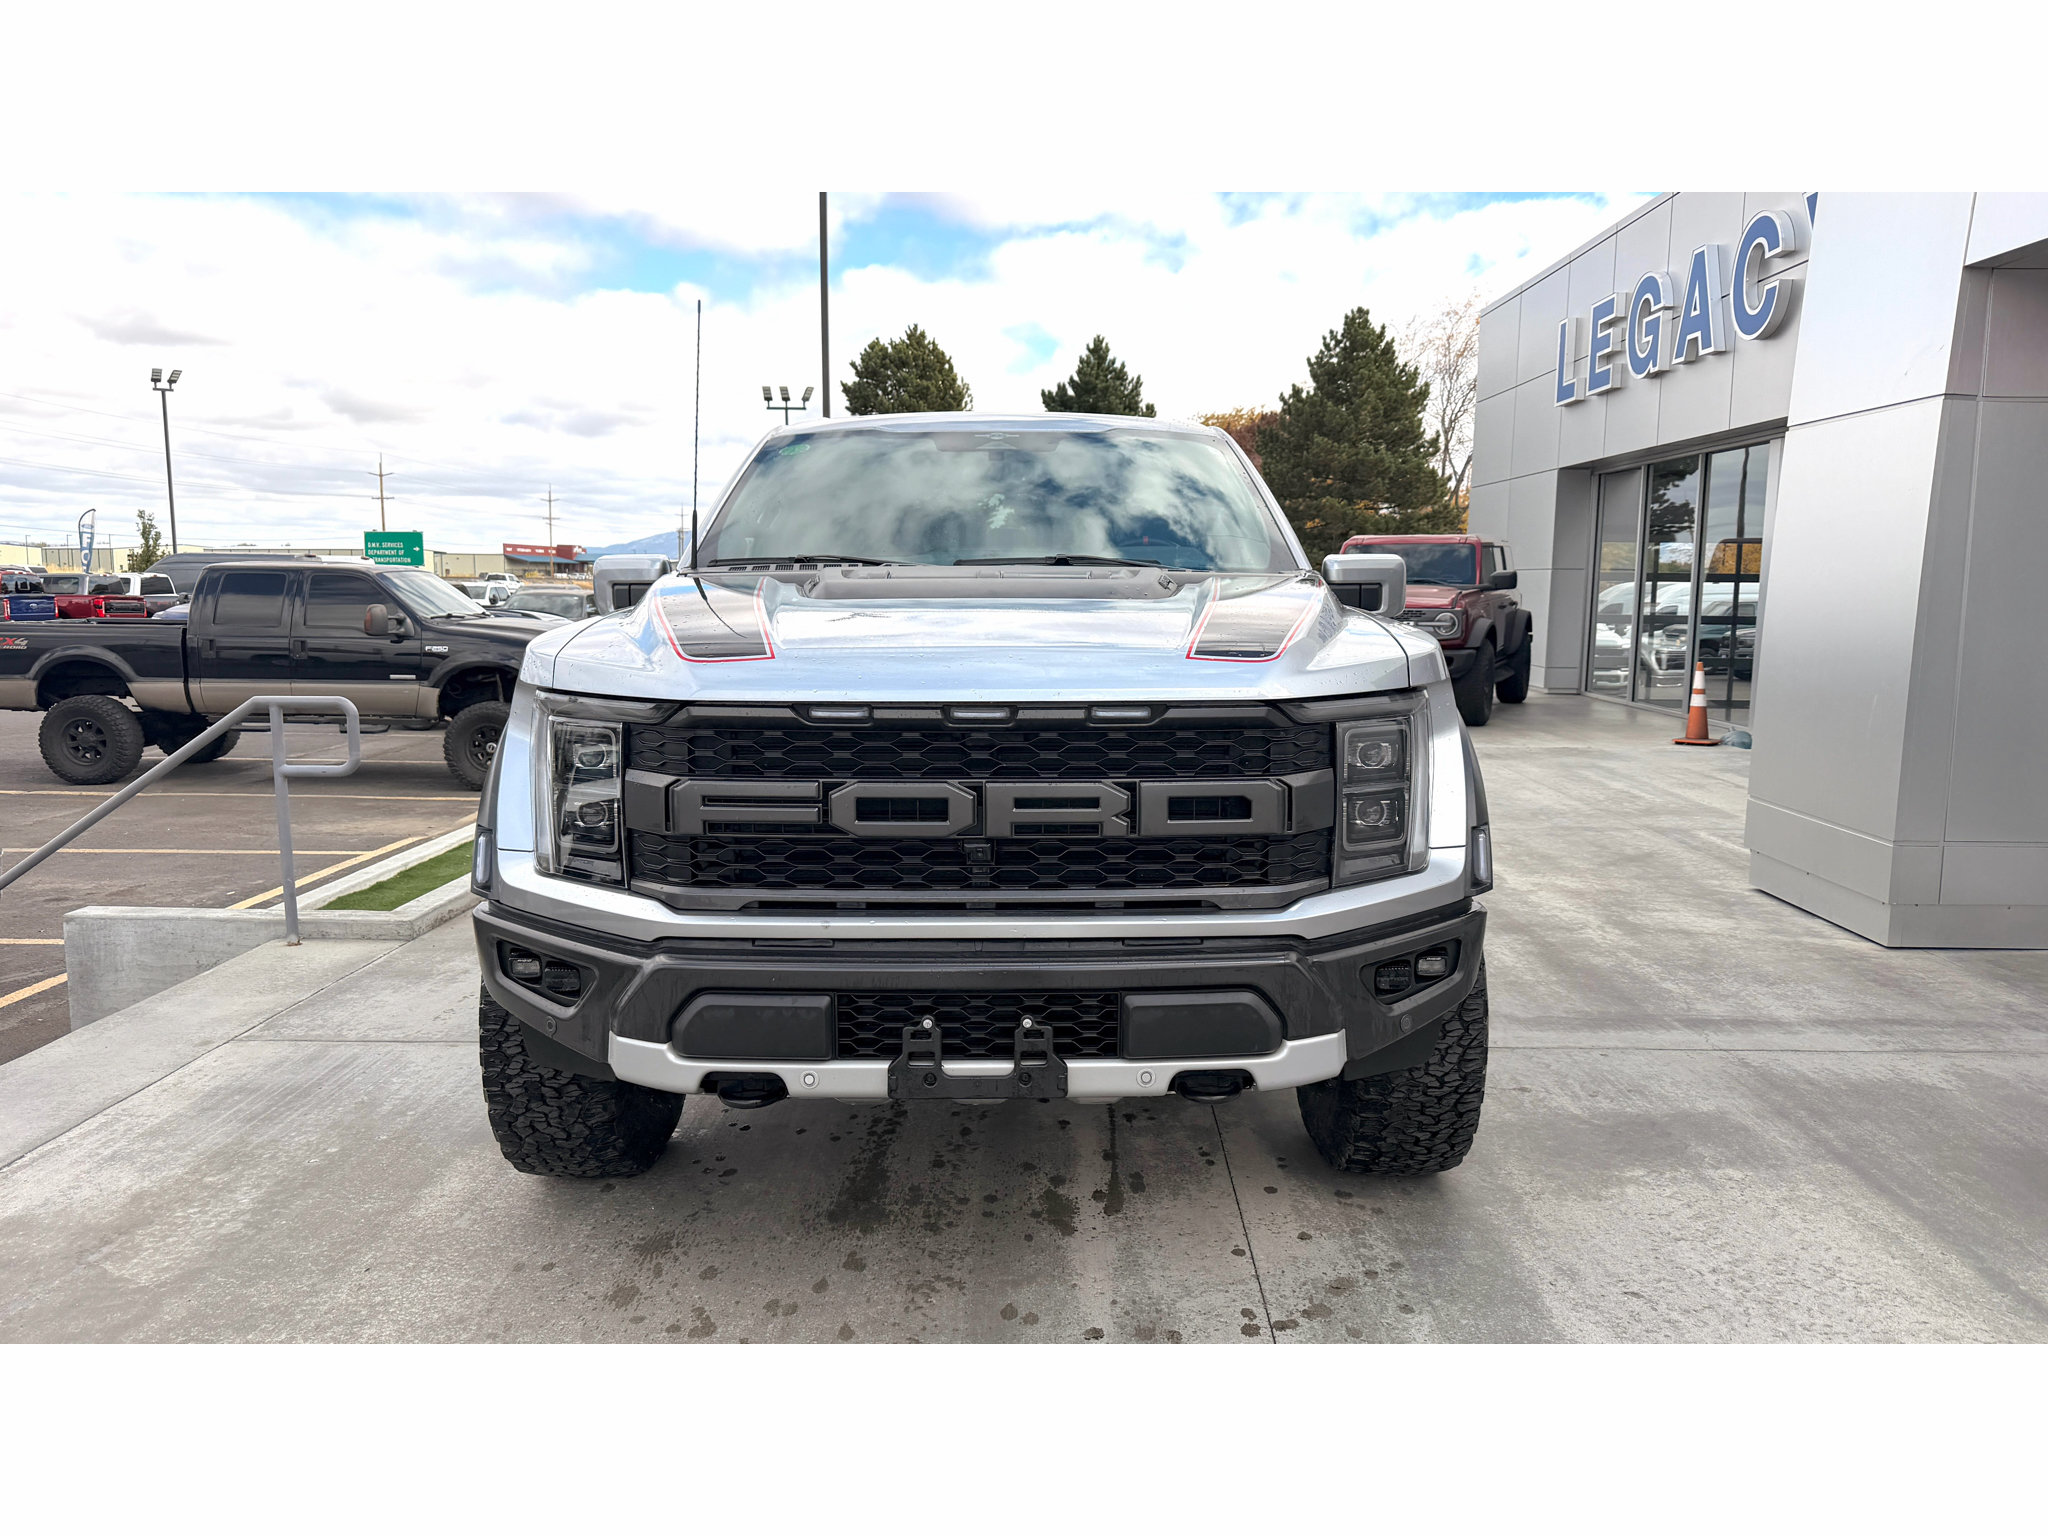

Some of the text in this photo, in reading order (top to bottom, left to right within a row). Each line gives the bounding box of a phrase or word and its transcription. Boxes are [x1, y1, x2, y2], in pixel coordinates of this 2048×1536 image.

[1554, 192, 1819, 408] LEGAC
[0, 637, 28, 645] X4
[673, 779, 1285, 837] FORD
